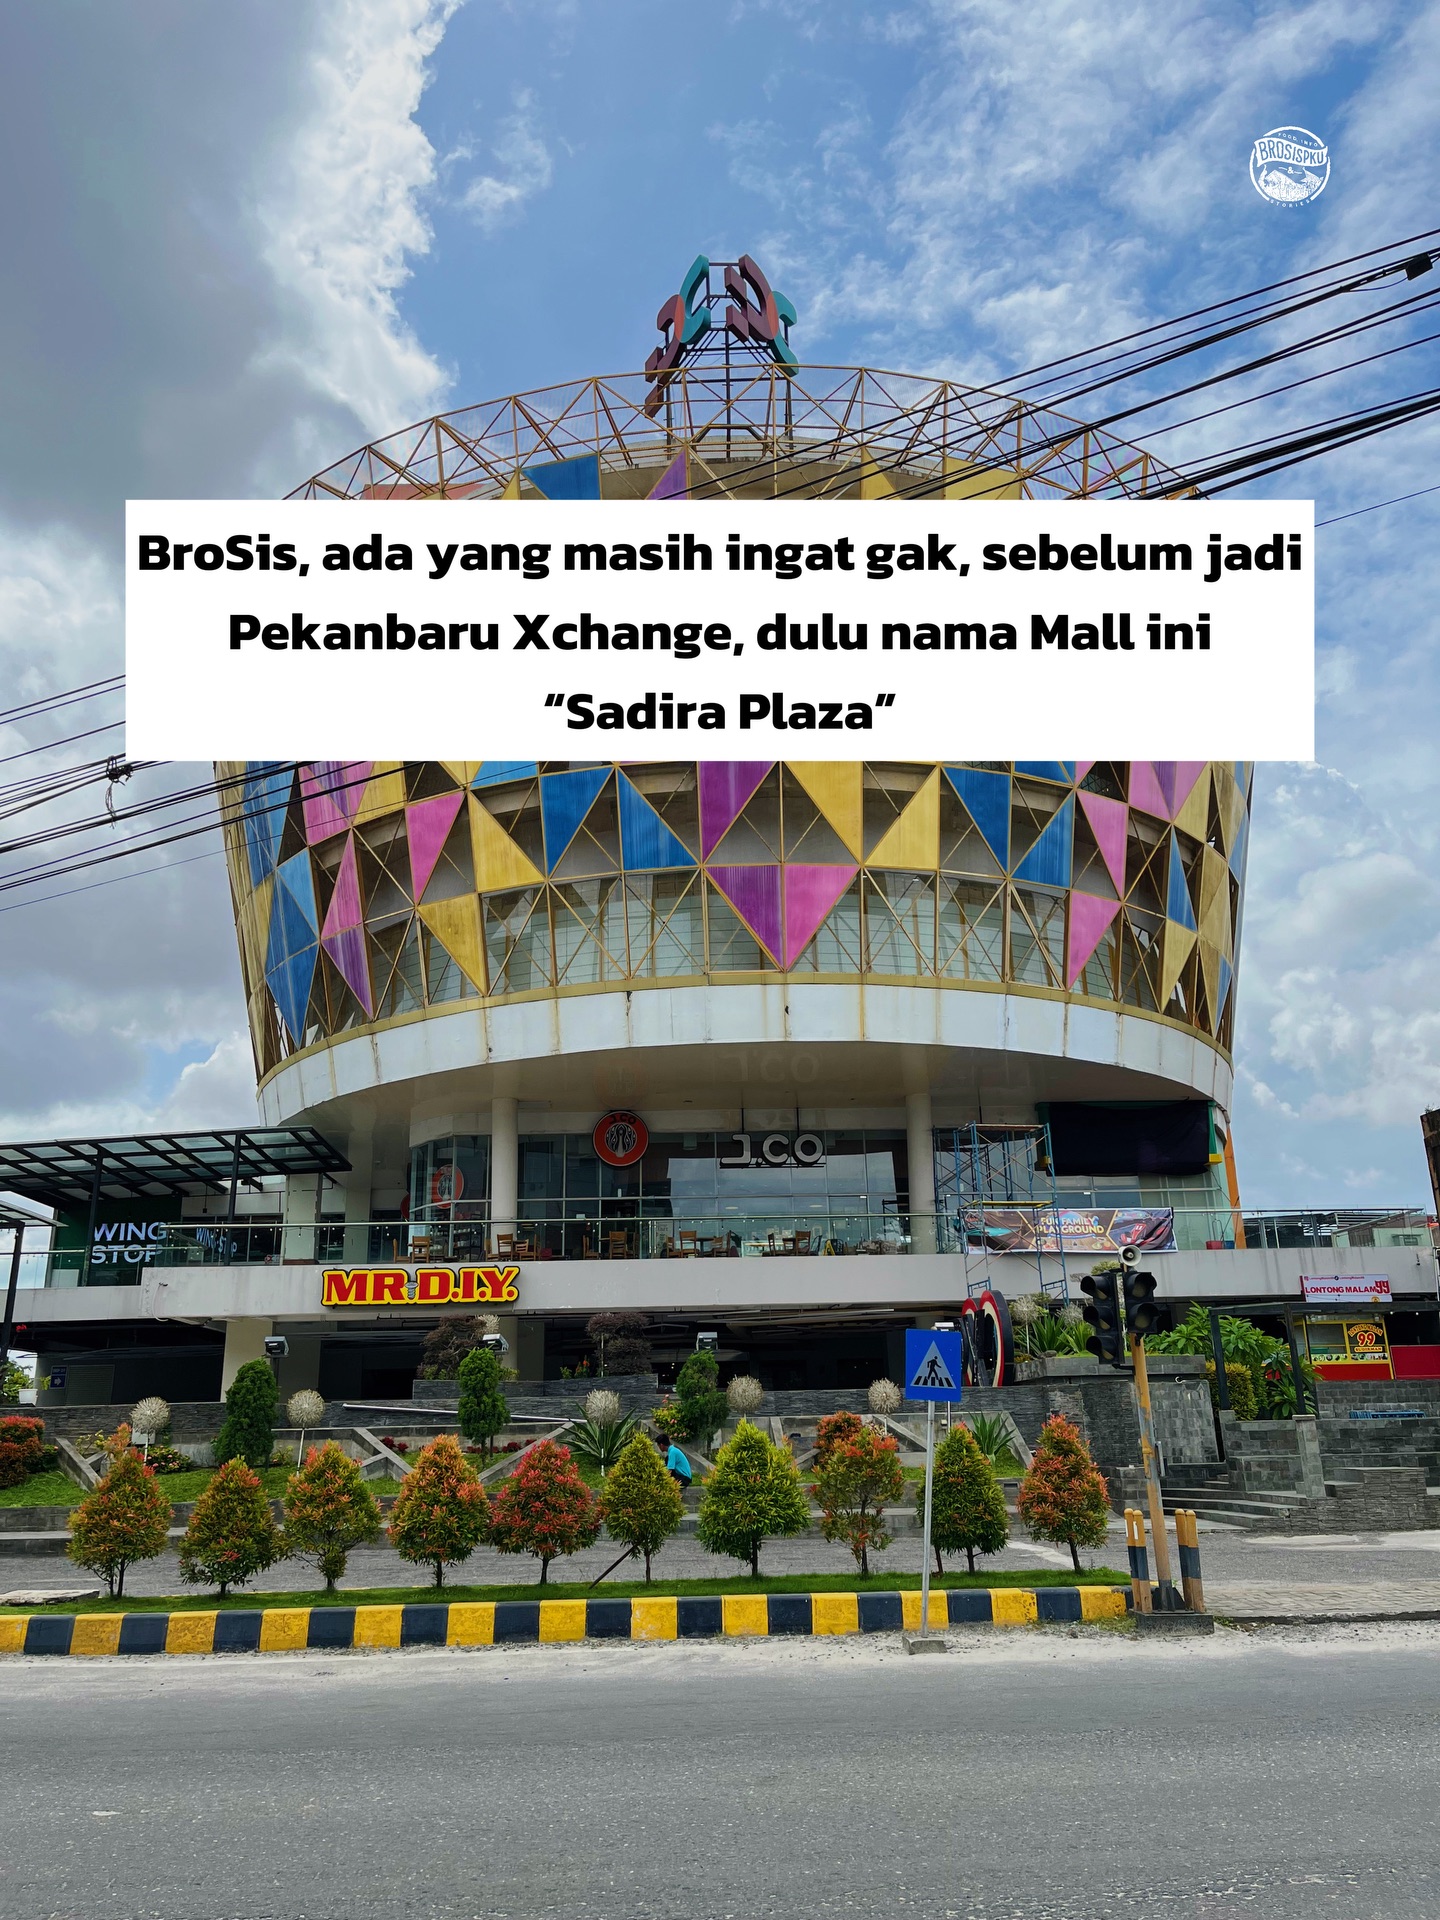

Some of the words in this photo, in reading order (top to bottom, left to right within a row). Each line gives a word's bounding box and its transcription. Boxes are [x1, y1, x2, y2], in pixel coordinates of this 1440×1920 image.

[720, 1133, 824, 1166] J.CO
[1062, 1217, 1096, 1226] FAMILY
[93, 1221, 167, 1242] WING
[91, 1244, 164, 1265] STOP
[1305, 1286, 1344, 1294] LONTONG
[1374, 1280, 1391, 1294] 99
[1357, 1332, 1375, 1347] 99
